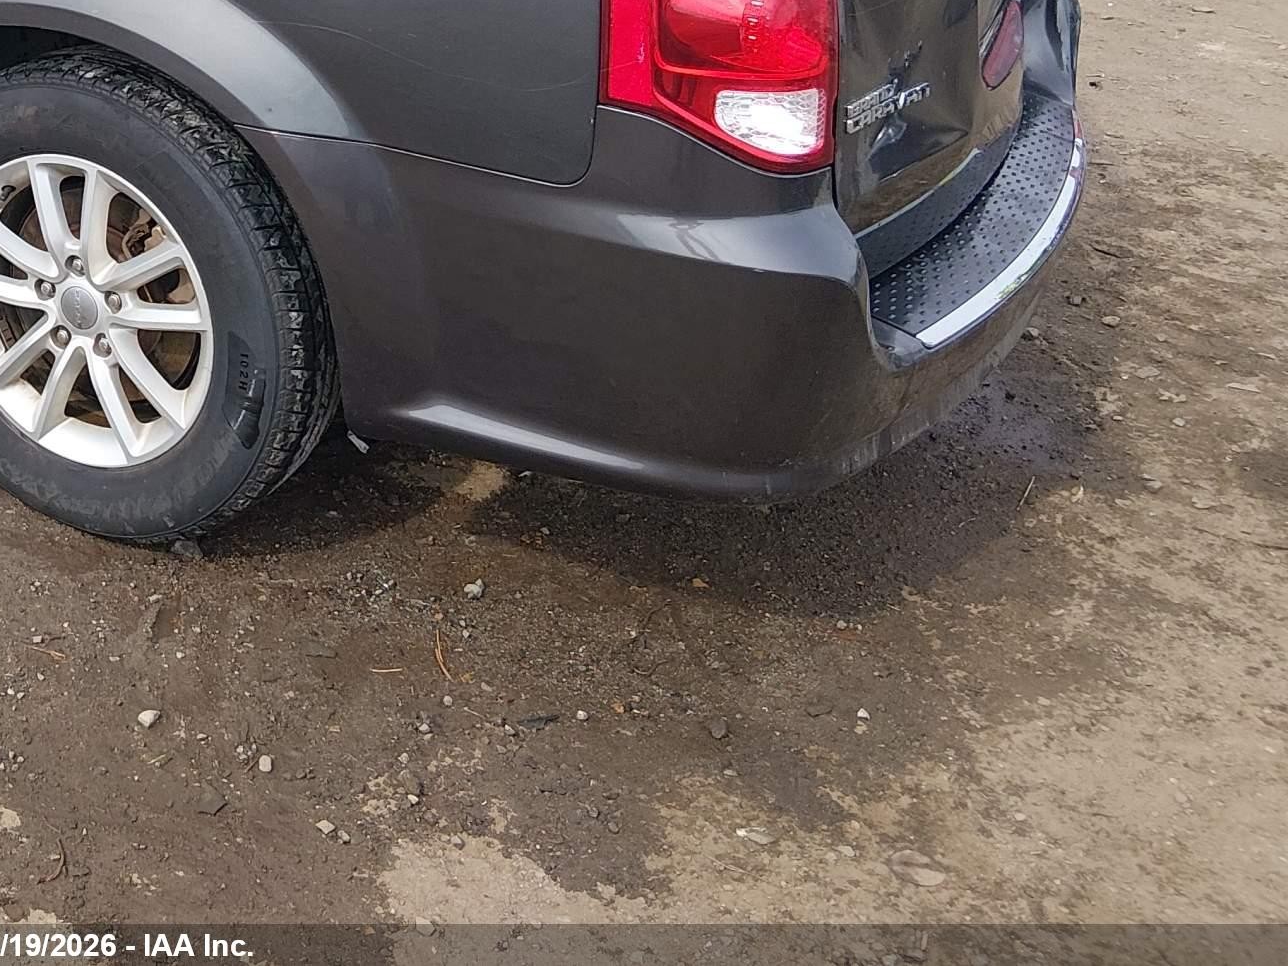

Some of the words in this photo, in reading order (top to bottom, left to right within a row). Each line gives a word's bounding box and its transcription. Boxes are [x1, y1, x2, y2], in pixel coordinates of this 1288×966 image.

[844, 82, 931, 135] CARAVAN
[845, 83, 896, 119] GRAND
[238, 352, 249, 392] 102H
